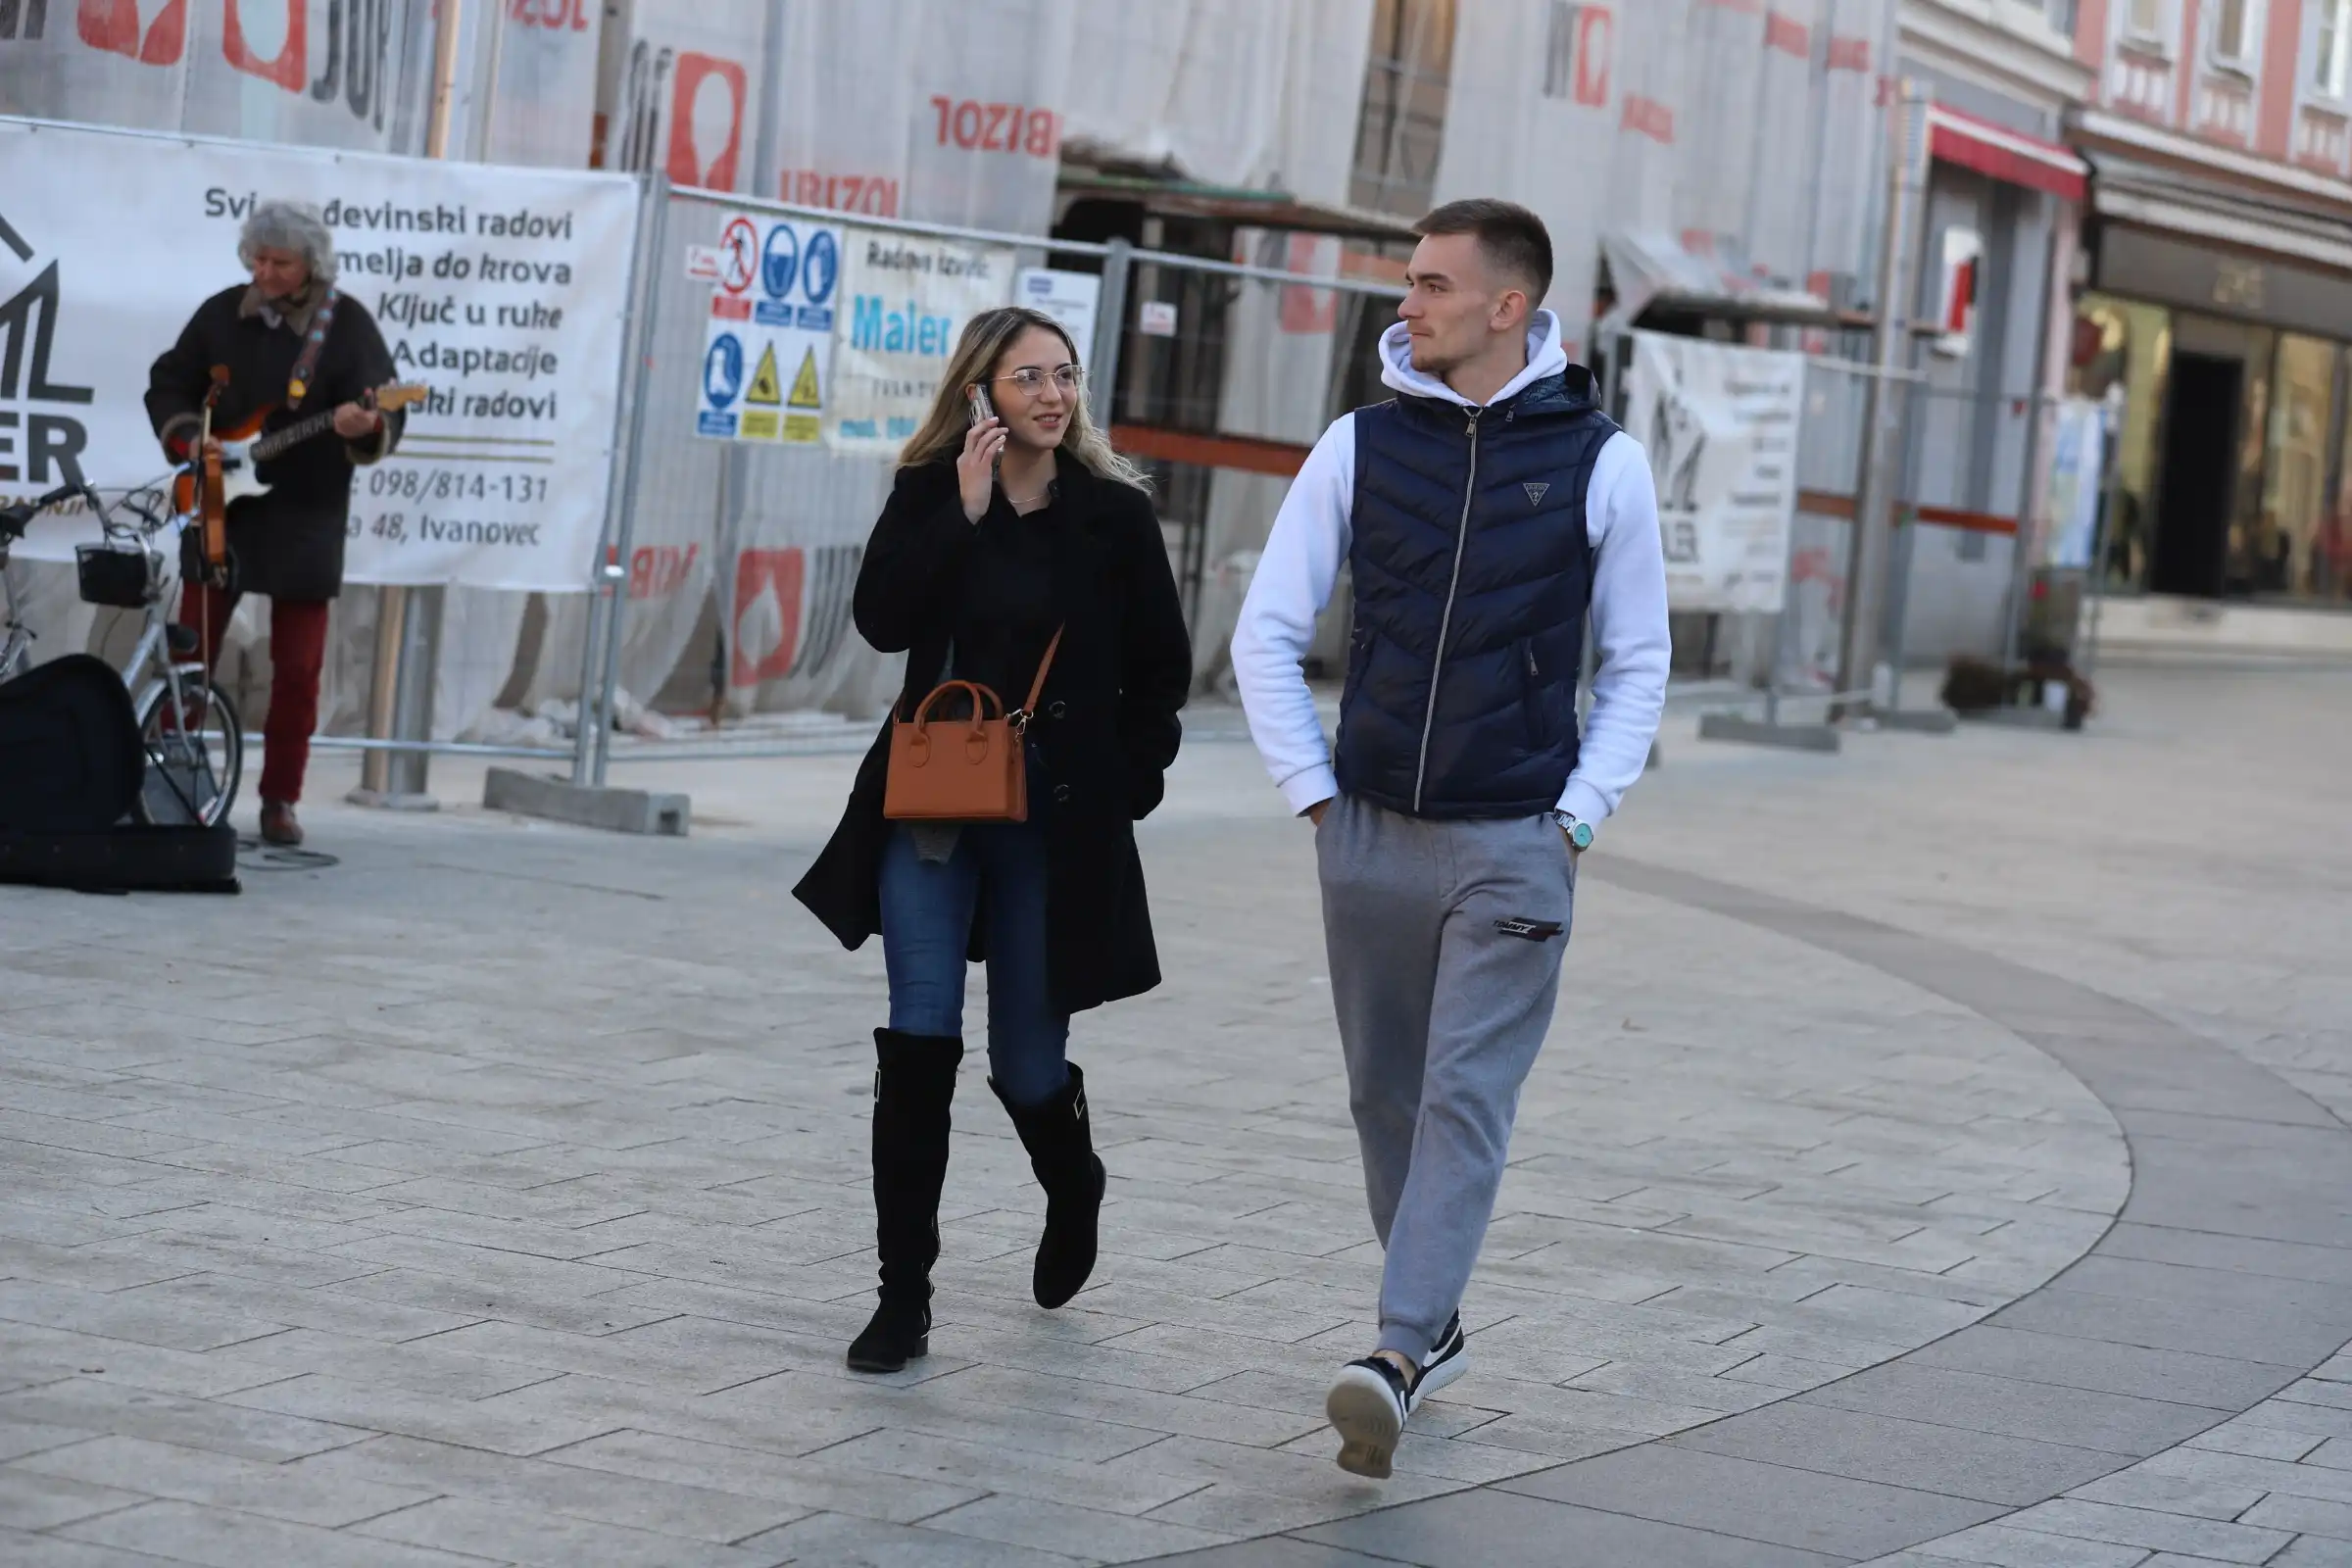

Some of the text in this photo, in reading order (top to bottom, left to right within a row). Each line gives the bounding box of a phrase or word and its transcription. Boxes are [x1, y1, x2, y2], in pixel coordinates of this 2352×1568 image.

[204, 187, 573, 241] Svi đevinski radovi
[337, 247, 572, 285] melja do krova
[377, 292, 564, 330] Ključ u ruke
[393, 339, 558, 380] Adaptacije
[463, 388, 557, 420] radovi
[369, 468, 548, 505] 098/814-131
[420, 513, 541, 547] Ivanovec
